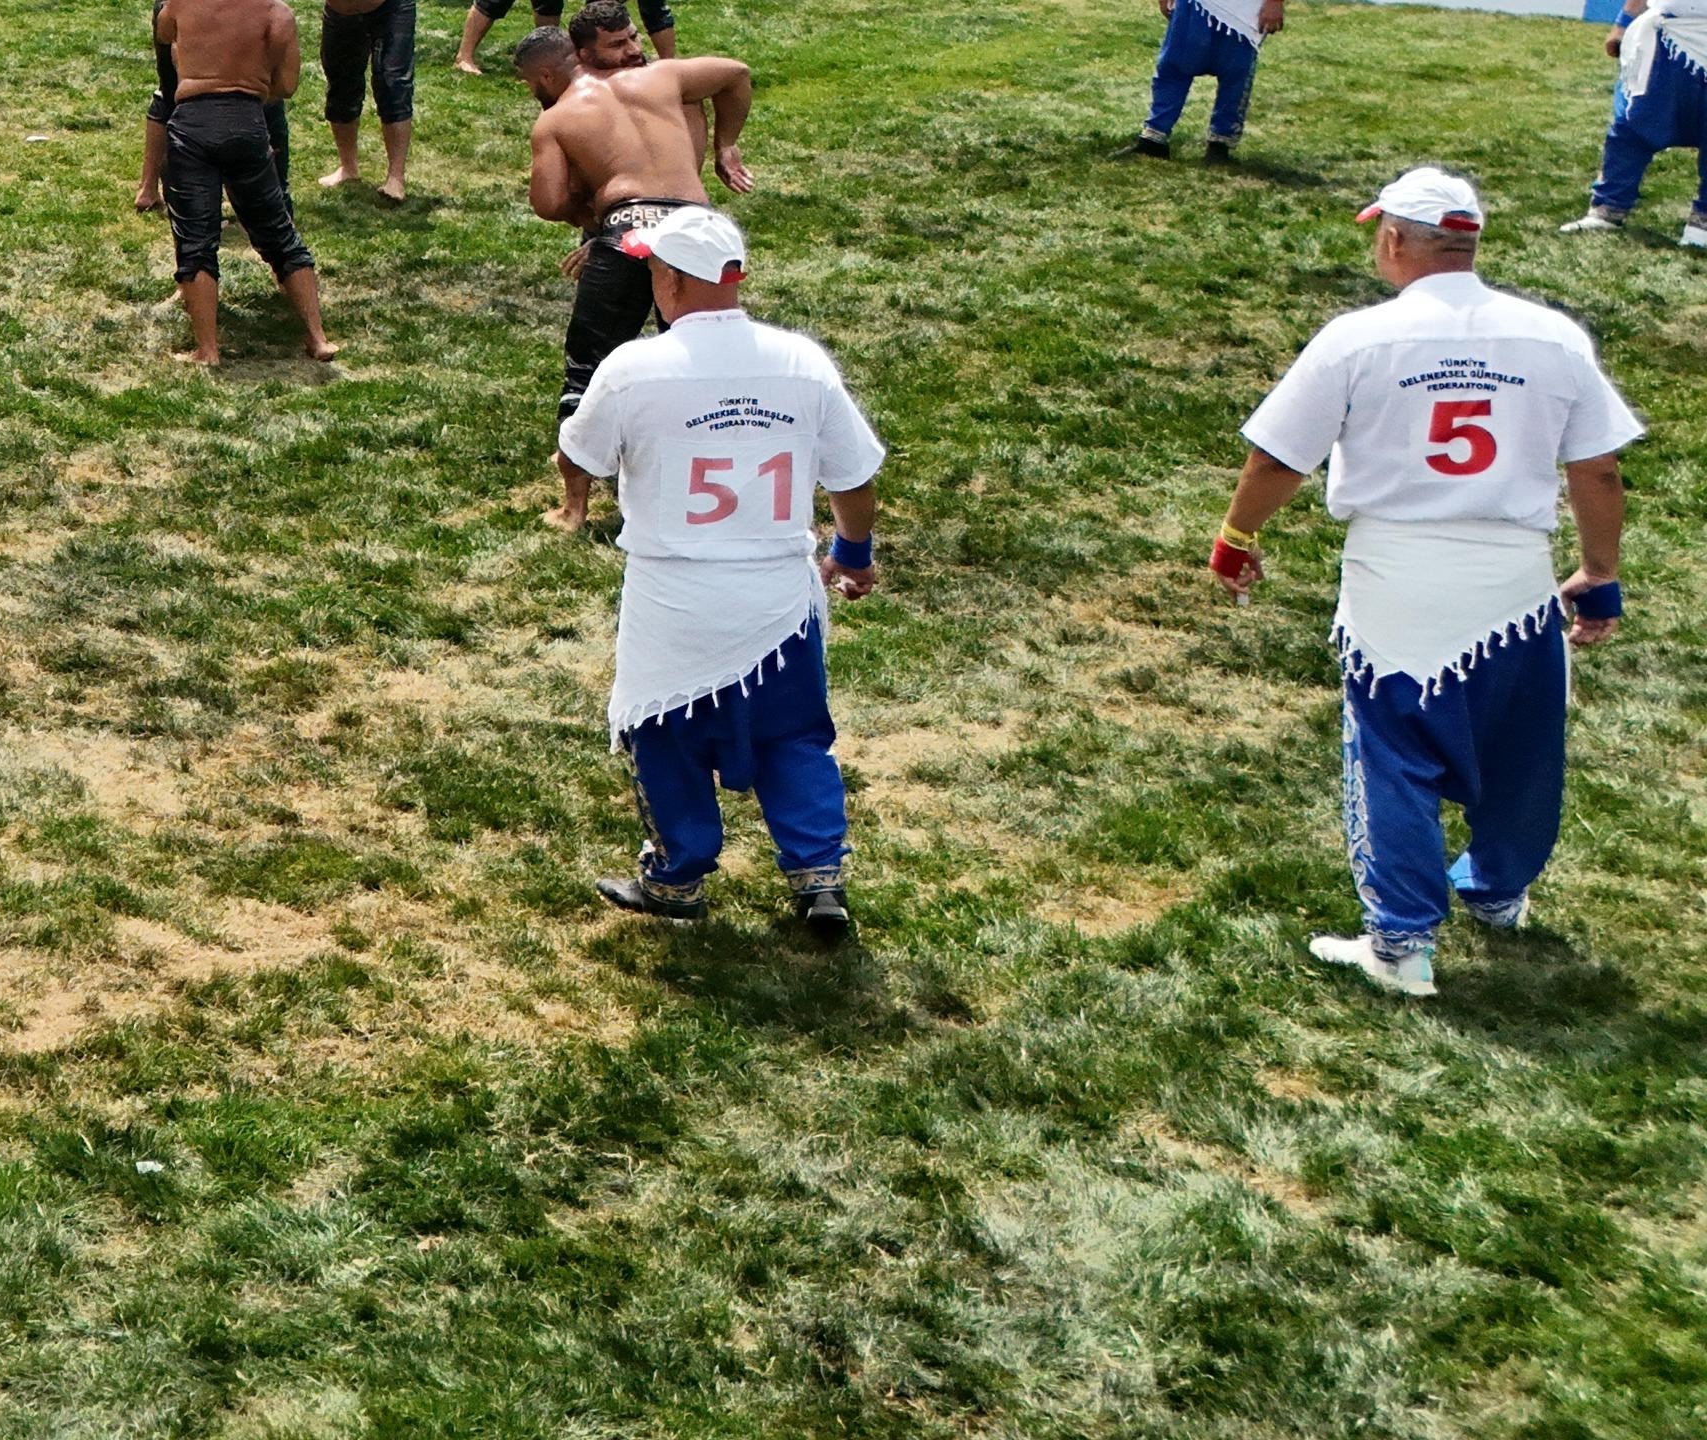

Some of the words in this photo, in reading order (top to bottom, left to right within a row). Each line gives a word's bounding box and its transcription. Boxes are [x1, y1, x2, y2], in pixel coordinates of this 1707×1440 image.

[1439, 357, 1487, 369] TÜRKİYE
[1398, 369, 1468, 389] GELENEKSEL
[1470, 368, 1526, 387] GÜREŞLER
[1427, 381, 1498, 392] FEDERASYONU
[718, 396, 758, 407] TÜRKİYE
[685, 408, 741, 429] GELENEKSEL
[743, 406, 795, 425] GÜREŞLER
[709, 419, 771, 431] FEDERASYONU
[1425, 399, 1497, 476] 5
[686, 451, 793, 525] 51
